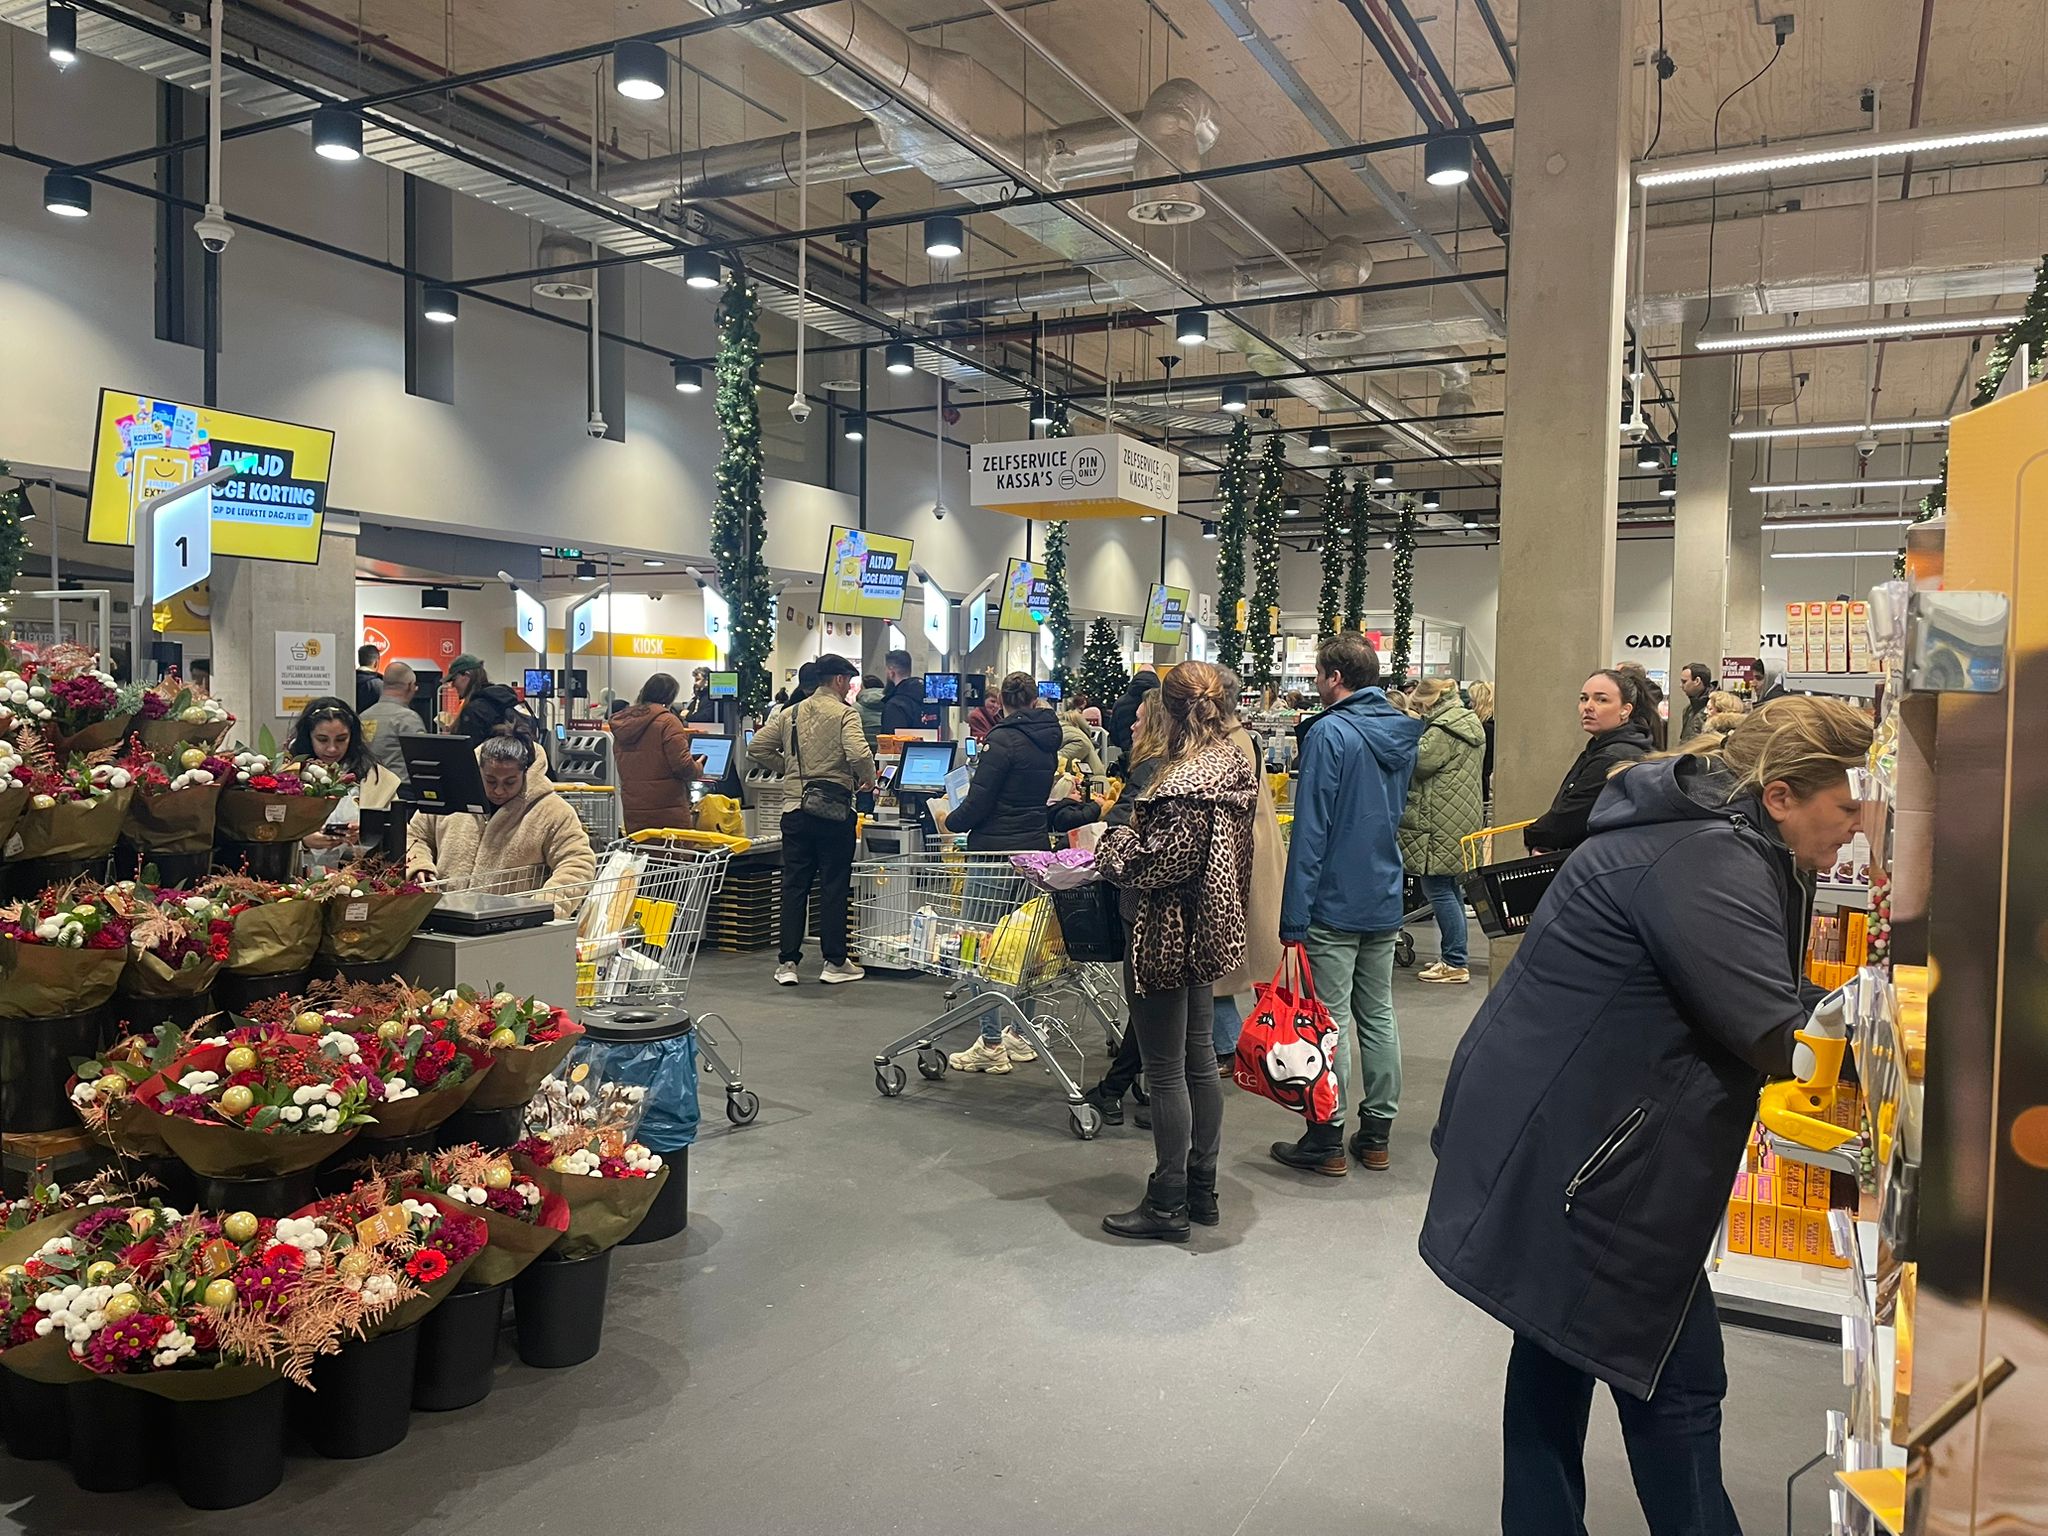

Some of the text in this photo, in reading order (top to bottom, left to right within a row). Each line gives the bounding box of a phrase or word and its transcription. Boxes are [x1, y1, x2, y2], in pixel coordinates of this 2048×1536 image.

[983, 451, 1067, 472] ZELFSERVICE
[1079, 456, 1098, 468] PIN
[1123, 448, 1160, 476] ZELFSERVICE
[997, 471, 1053, 490] KASSA'S
[1078, 468, 1098, 478] ONLY
[1130, 469, 1154, 492] KASSA'S
[212, 480, 316, 506] OGE KORTING
[213, 506, 224, 514] OP
[225, 506, 235, 516] DE
[237, 508, 266, 519] LEUKSTE
[268, 511, 296, 520] DAGJES
[175, 536, 188, 567] 1
[527, 617, 534, 632] 6
[579, 621, 586, 636] 9
[713, 616, 720, 632] 5
[632, 637, 664, 655] KIOSK
